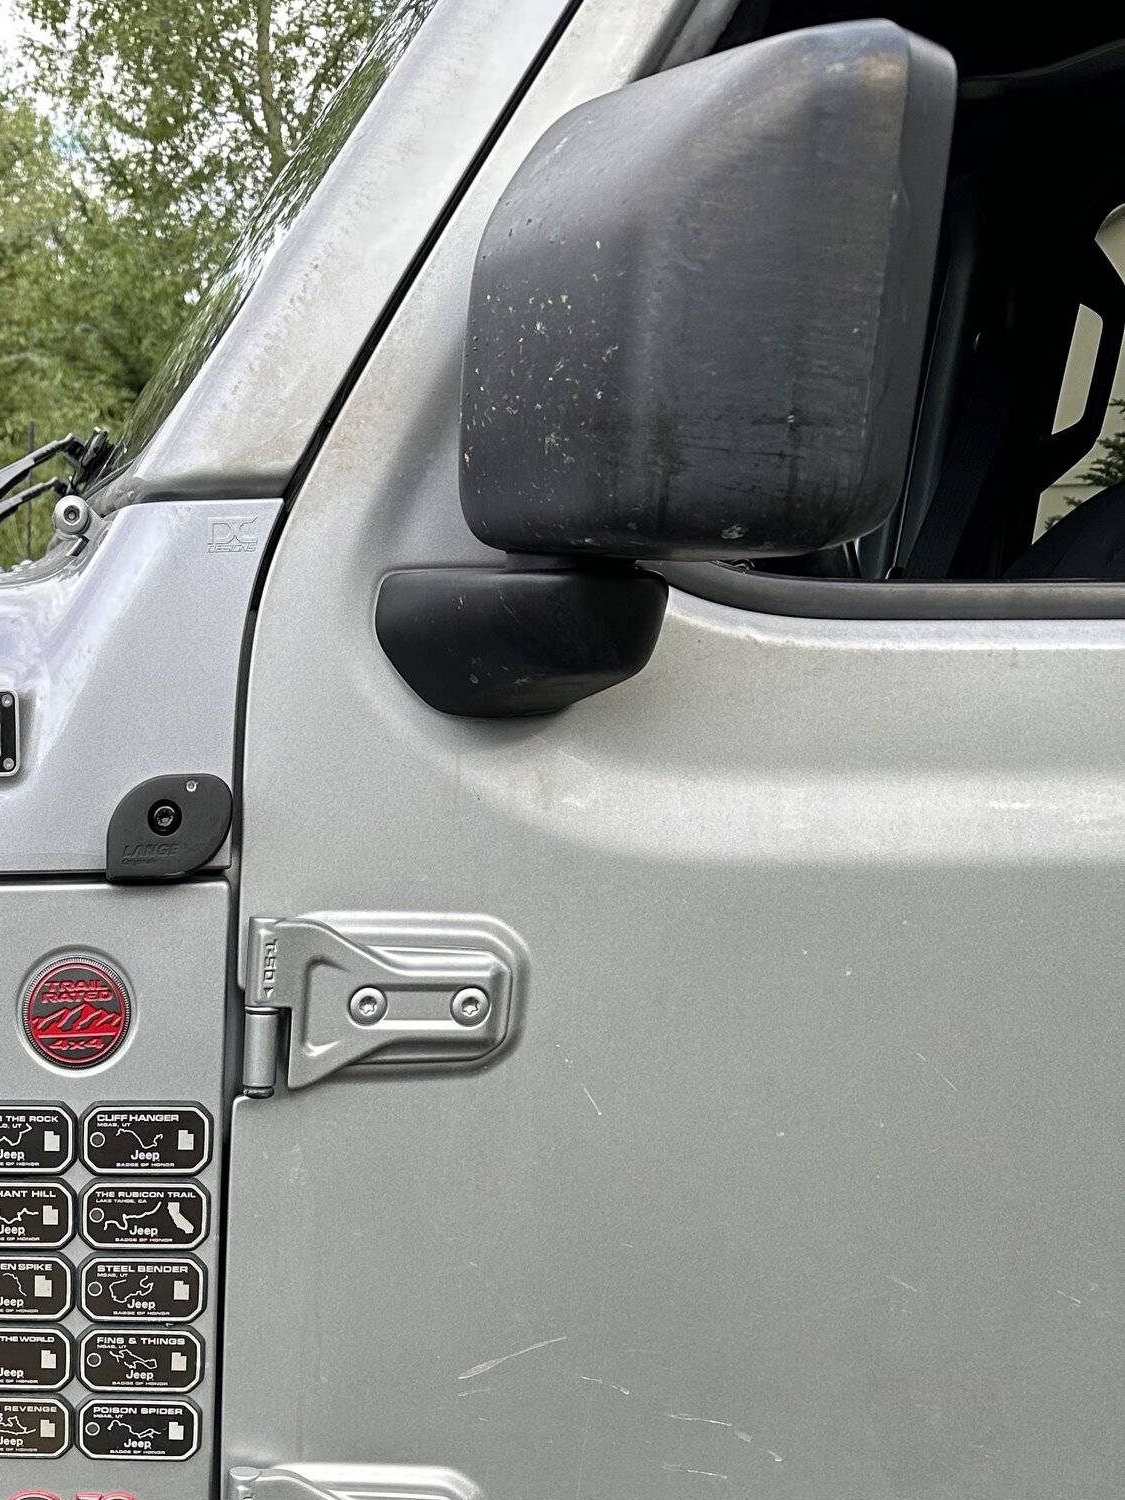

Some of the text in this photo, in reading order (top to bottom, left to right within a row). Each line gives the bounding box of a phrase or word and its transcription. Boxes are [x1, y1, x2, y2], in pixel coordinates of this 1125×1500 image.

[44, 978, 109, 993] TRAIL
[41, 989, 114, 1004] RATED
[48, 1038, 105, 1051] 4x4
[6, 1114, 26, 1122] THE
[29, 1114, 58, 1123] ROCK
[97, 1114, 179, 1122] CLIFF HANGER
[131, 1150, 159, 1161] Jeep
[31, 1190, 56, 1198] HILL
[129, 1226, 158, 1236] Jeep
[18, 1263, 52, 1271] SPIKE
[97, 1265, 188, 1273] STEEL BENDER
[127, 1299, 156, 1309] Jeep
[97, 1337, 185, 1345] FINS & THINGS
[126, 1370, 154, 1380] Jeep
[4, 1404, 57, 1412] REVENGE
[141, 1407, 183, 1415] SPIDER
[124, 1439, 151, 1450] Jeep
